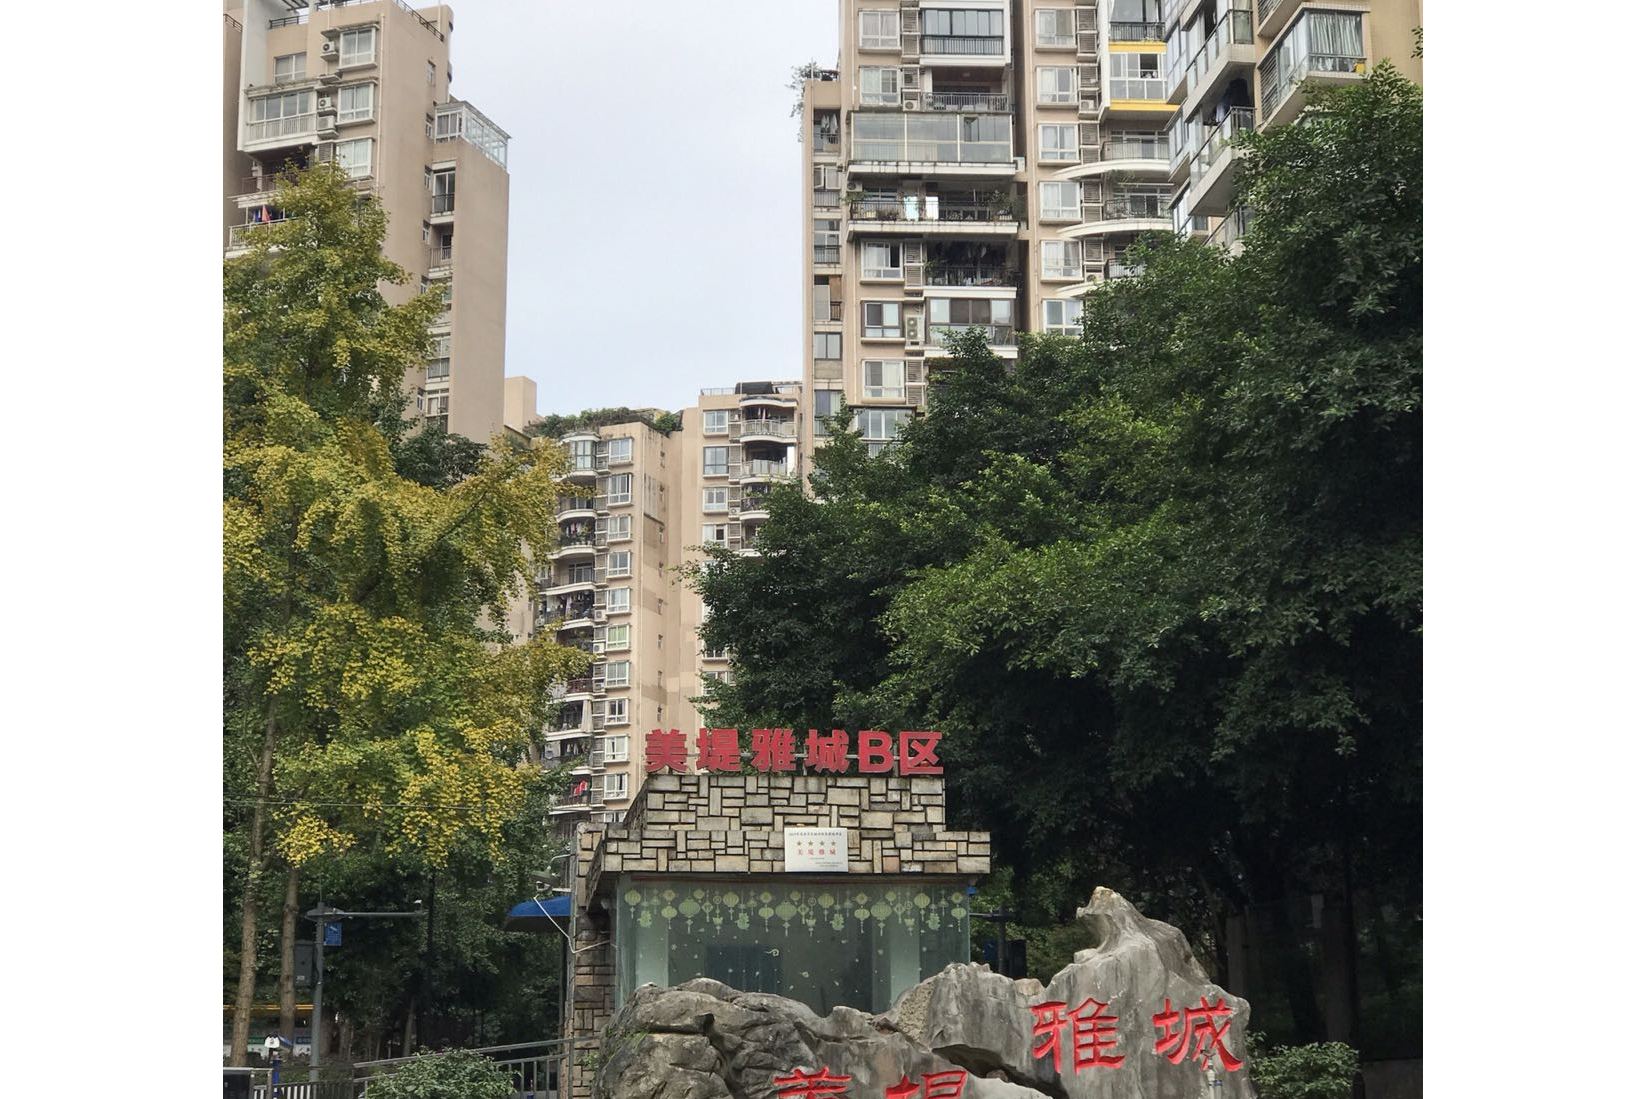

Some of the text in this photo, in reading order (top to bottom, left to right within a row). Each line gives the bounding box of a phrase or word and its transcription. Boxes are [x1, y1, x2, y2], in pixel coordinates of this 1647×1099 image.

[645, 728, 944, 775] 美堤雅城B区
[1031, 996, 1243, 1074] 雅城
